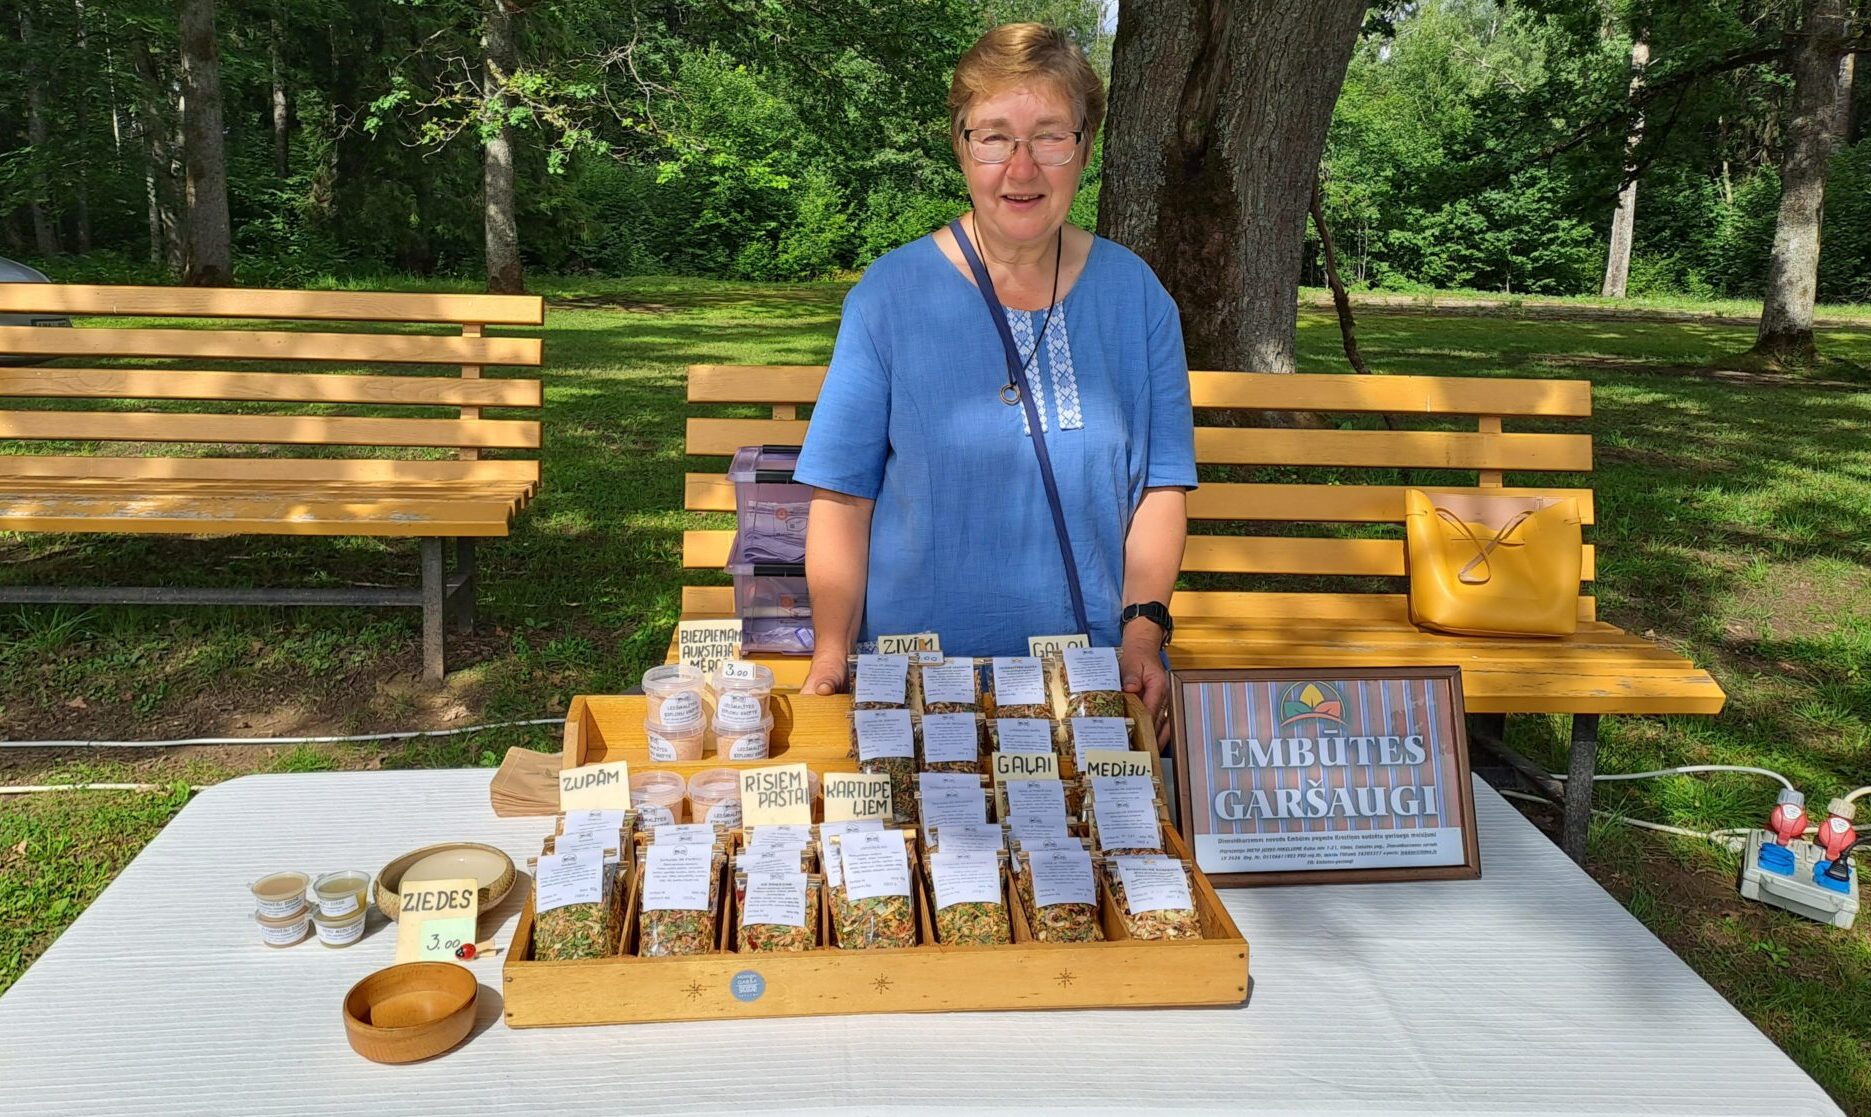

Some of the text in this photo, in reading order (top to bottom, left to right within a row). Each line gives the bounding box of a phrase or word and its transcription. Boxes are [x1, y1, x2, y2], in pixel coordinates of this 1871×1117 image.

[726, 663, 748, 676] 3.00
[1219, 729, 1426, 768] EMBŪTES
[998, 755, 1051, 775] GAĻAI
[563, 769, 619, 792] ZUPĀM
[745, 771, 801, 792] RĪSIEM
[826, 780, 890, 799] KARTUPE
[757, 787, 808, 809] PASTAI
[1214, 778, 1438, 820] GARŠAUGI
[402, 889, 473, 912] ZIEDES
[426, 934, 461, 951] 3.00
